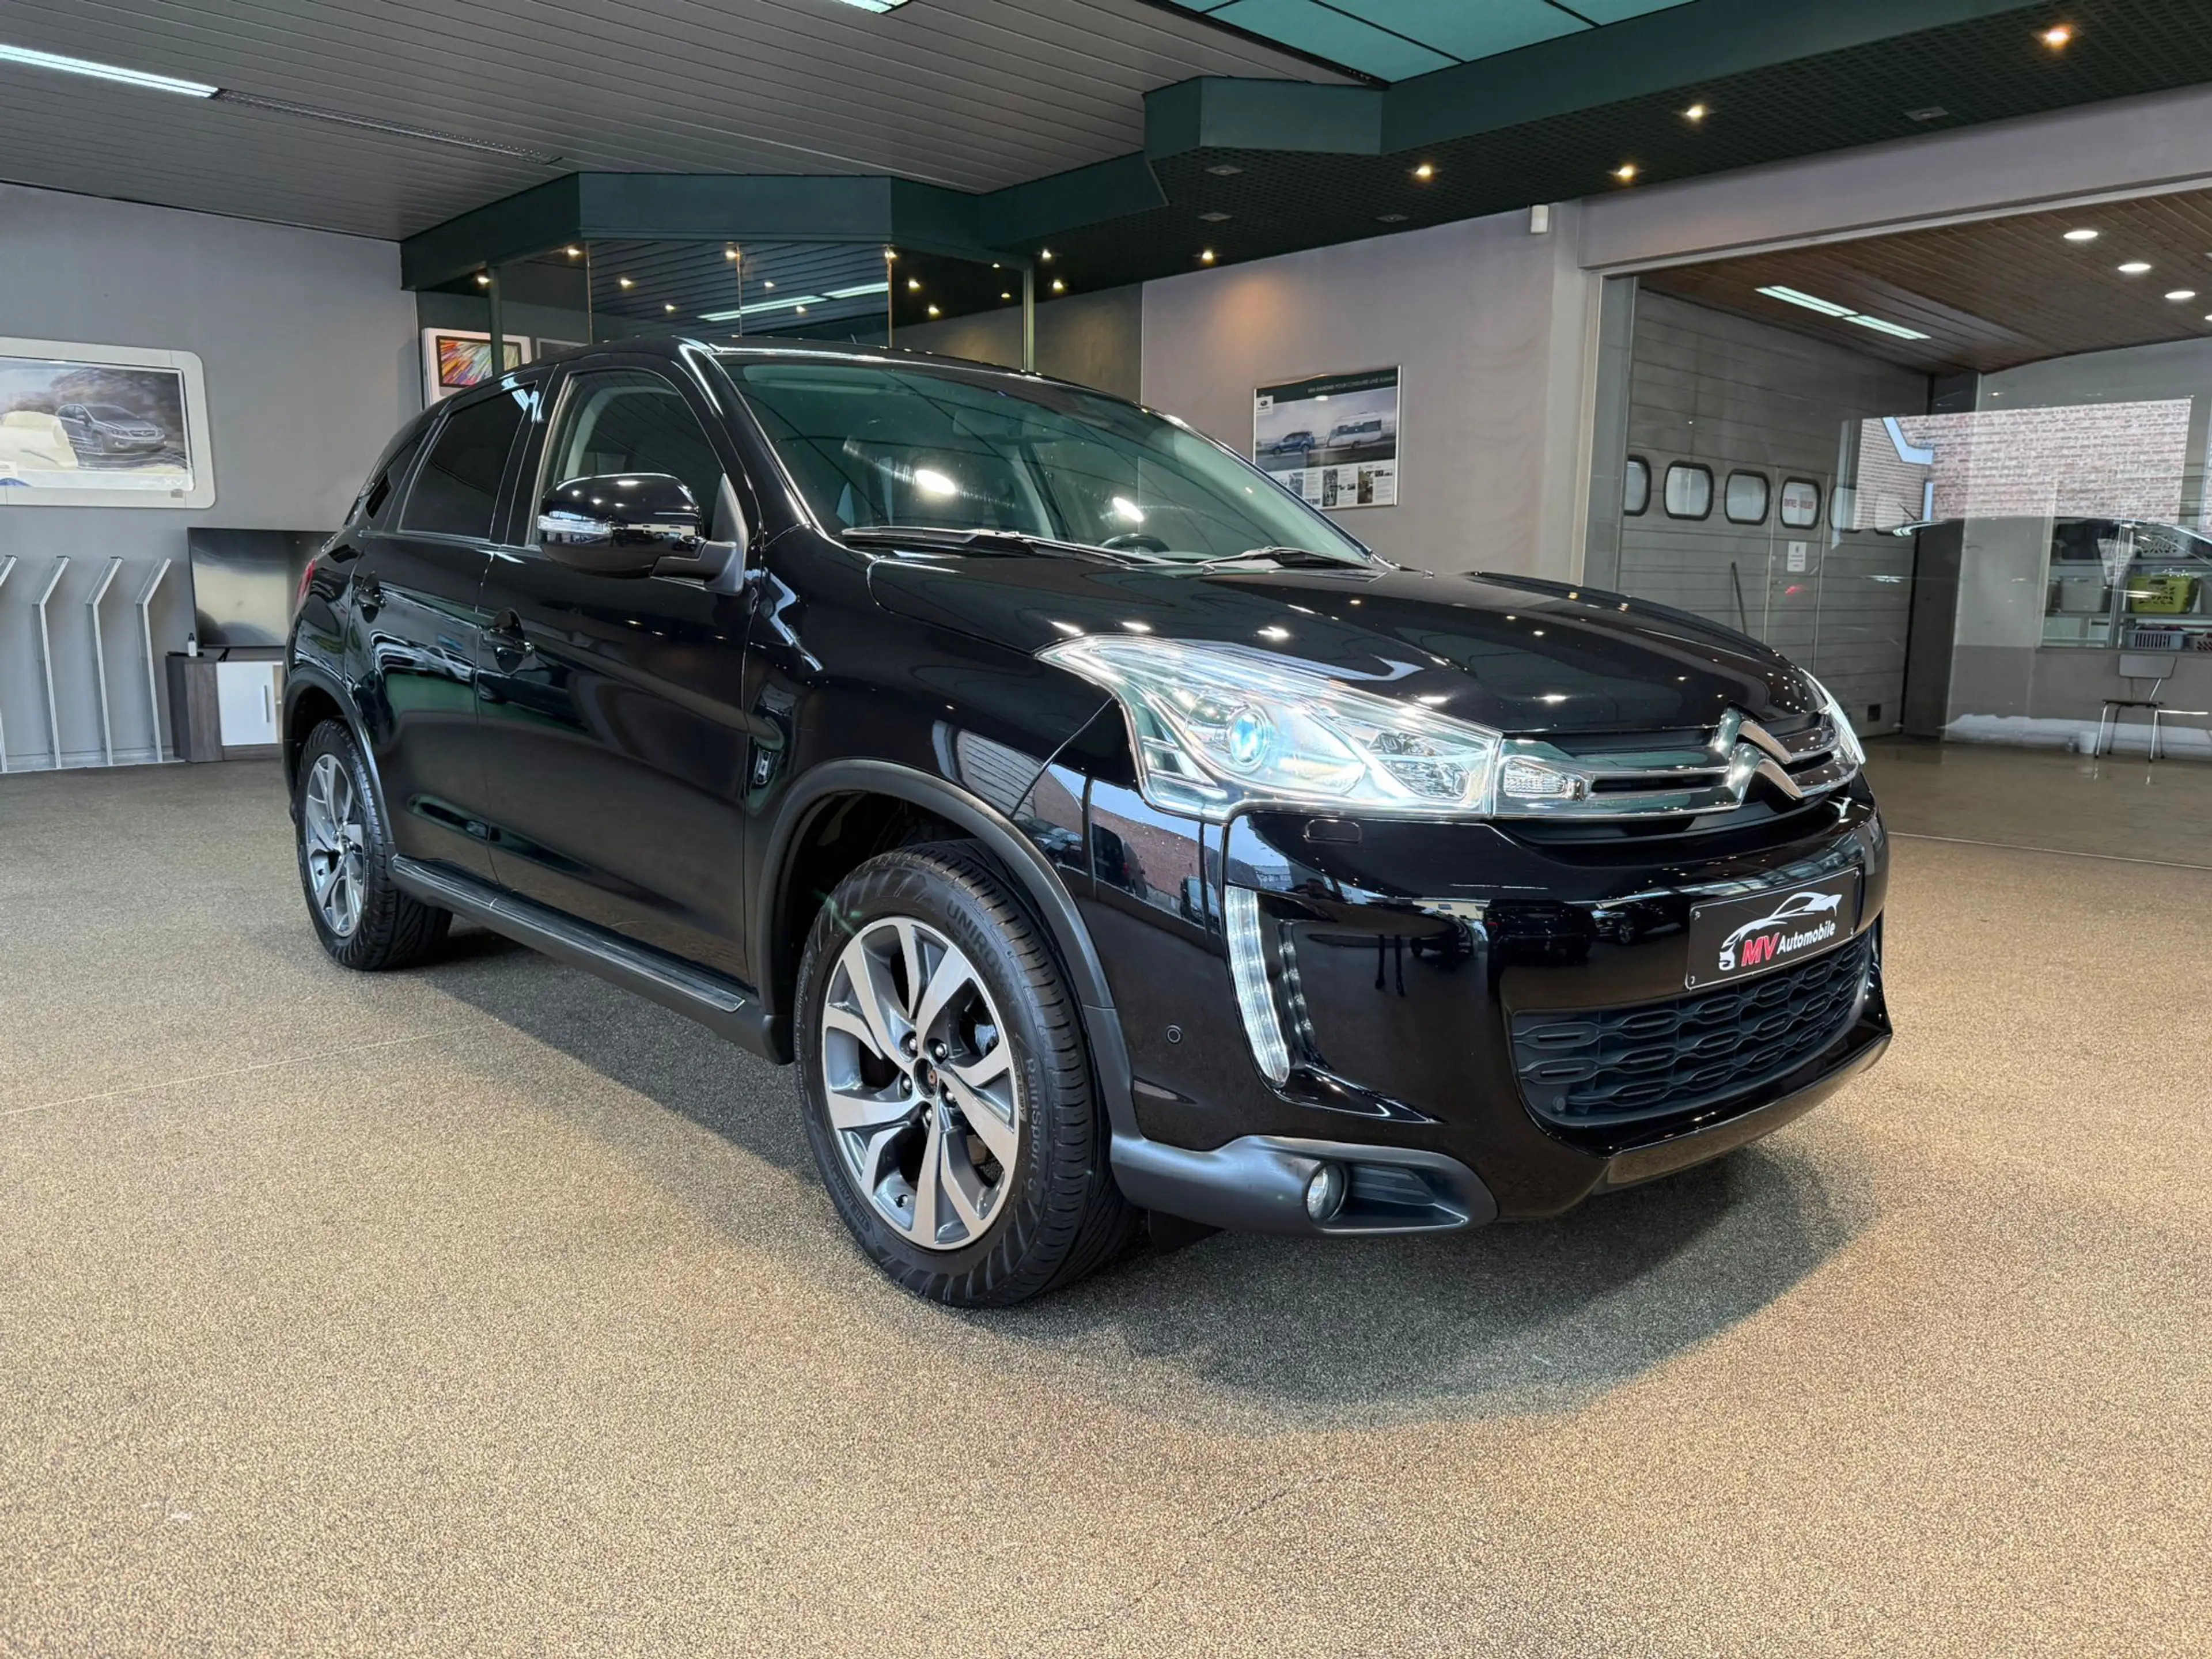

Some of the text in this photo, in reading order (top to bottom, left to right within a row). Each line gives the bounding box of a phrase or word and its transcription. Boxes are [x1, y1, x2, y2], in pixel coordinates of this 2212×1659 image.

[1741, 920, 1836, 968] MV Automobile
[1025, 1058, 1041, 1173] RainSport
